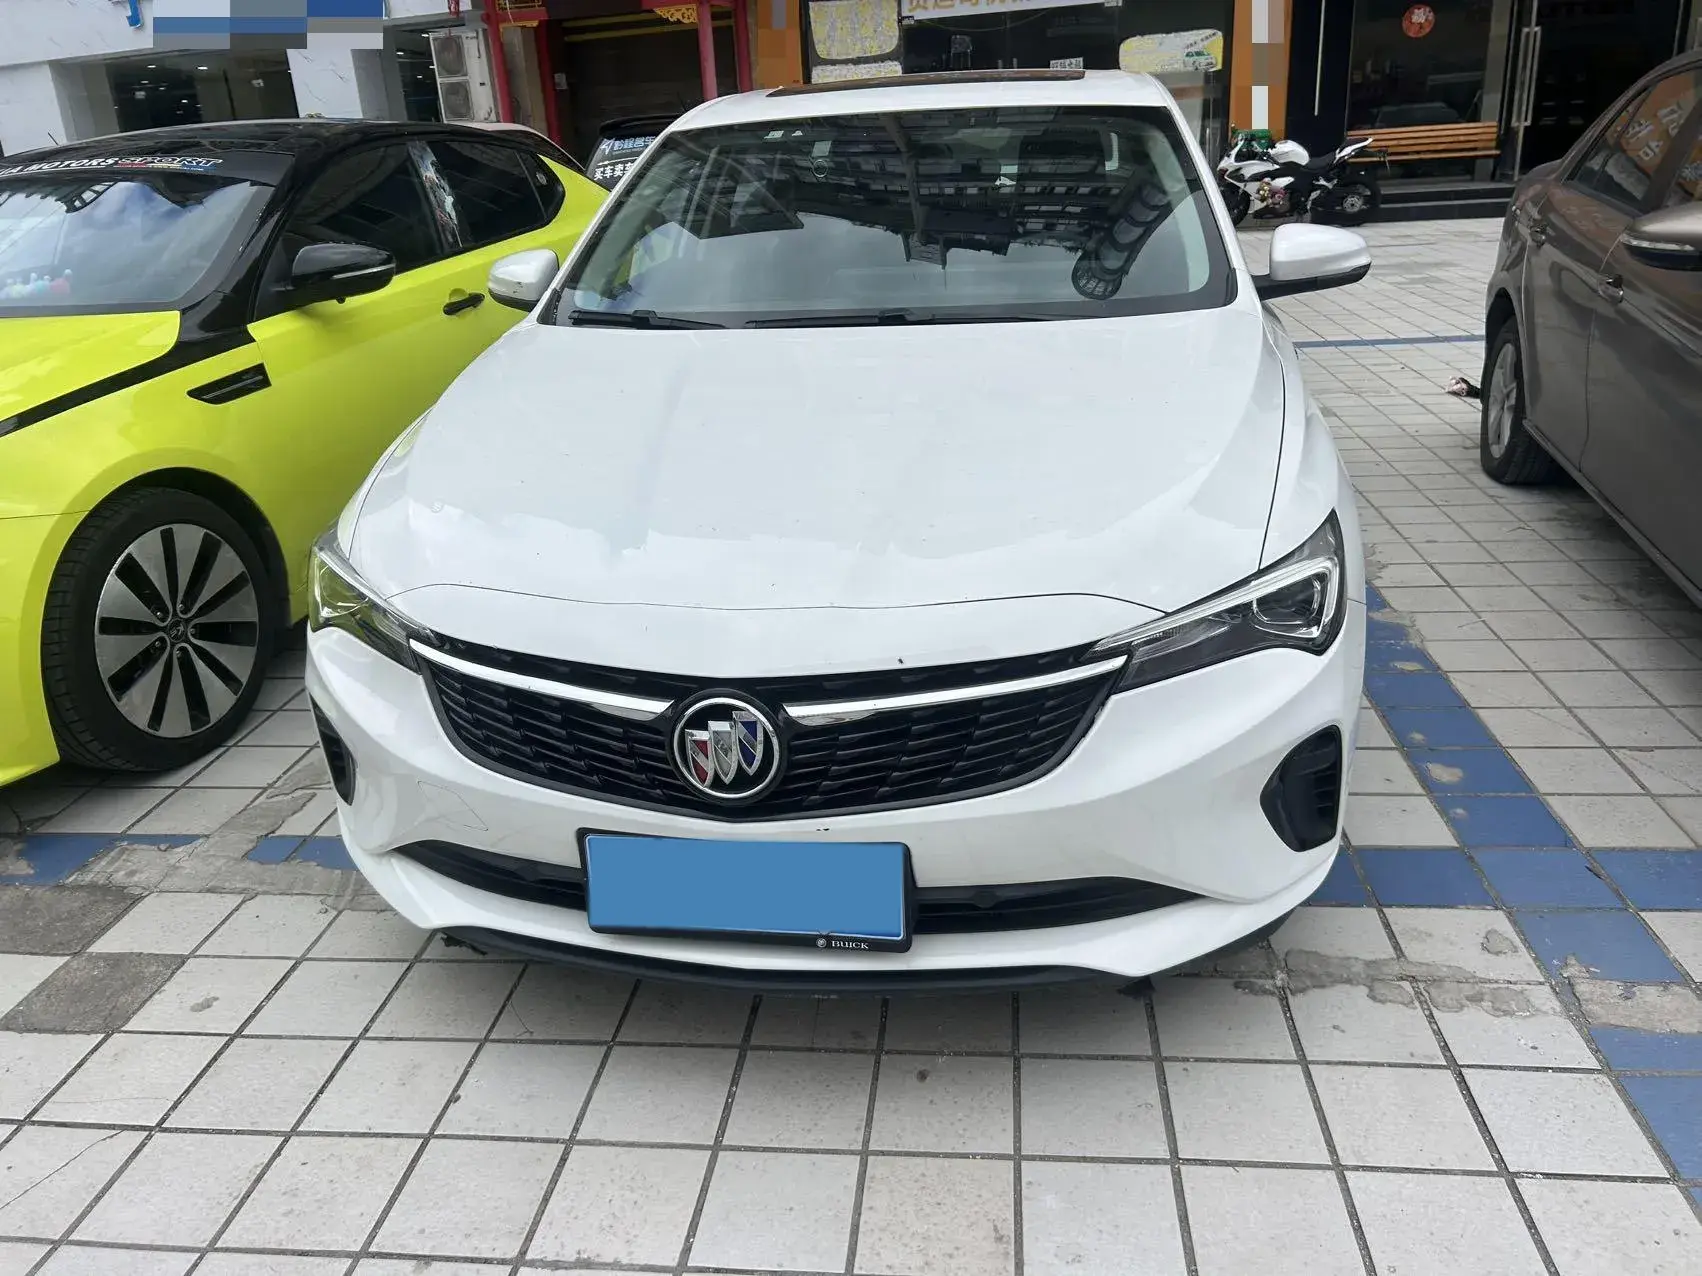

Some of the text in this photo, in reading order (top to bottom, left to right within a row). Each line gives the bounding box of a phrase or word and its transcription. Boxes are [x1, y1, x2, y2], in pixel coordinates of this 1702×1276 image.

[23, 157, 119, 172] MOTORS
[117, 156, 223, 167] SPORT
[831, 940, 869, 949] BUICK
